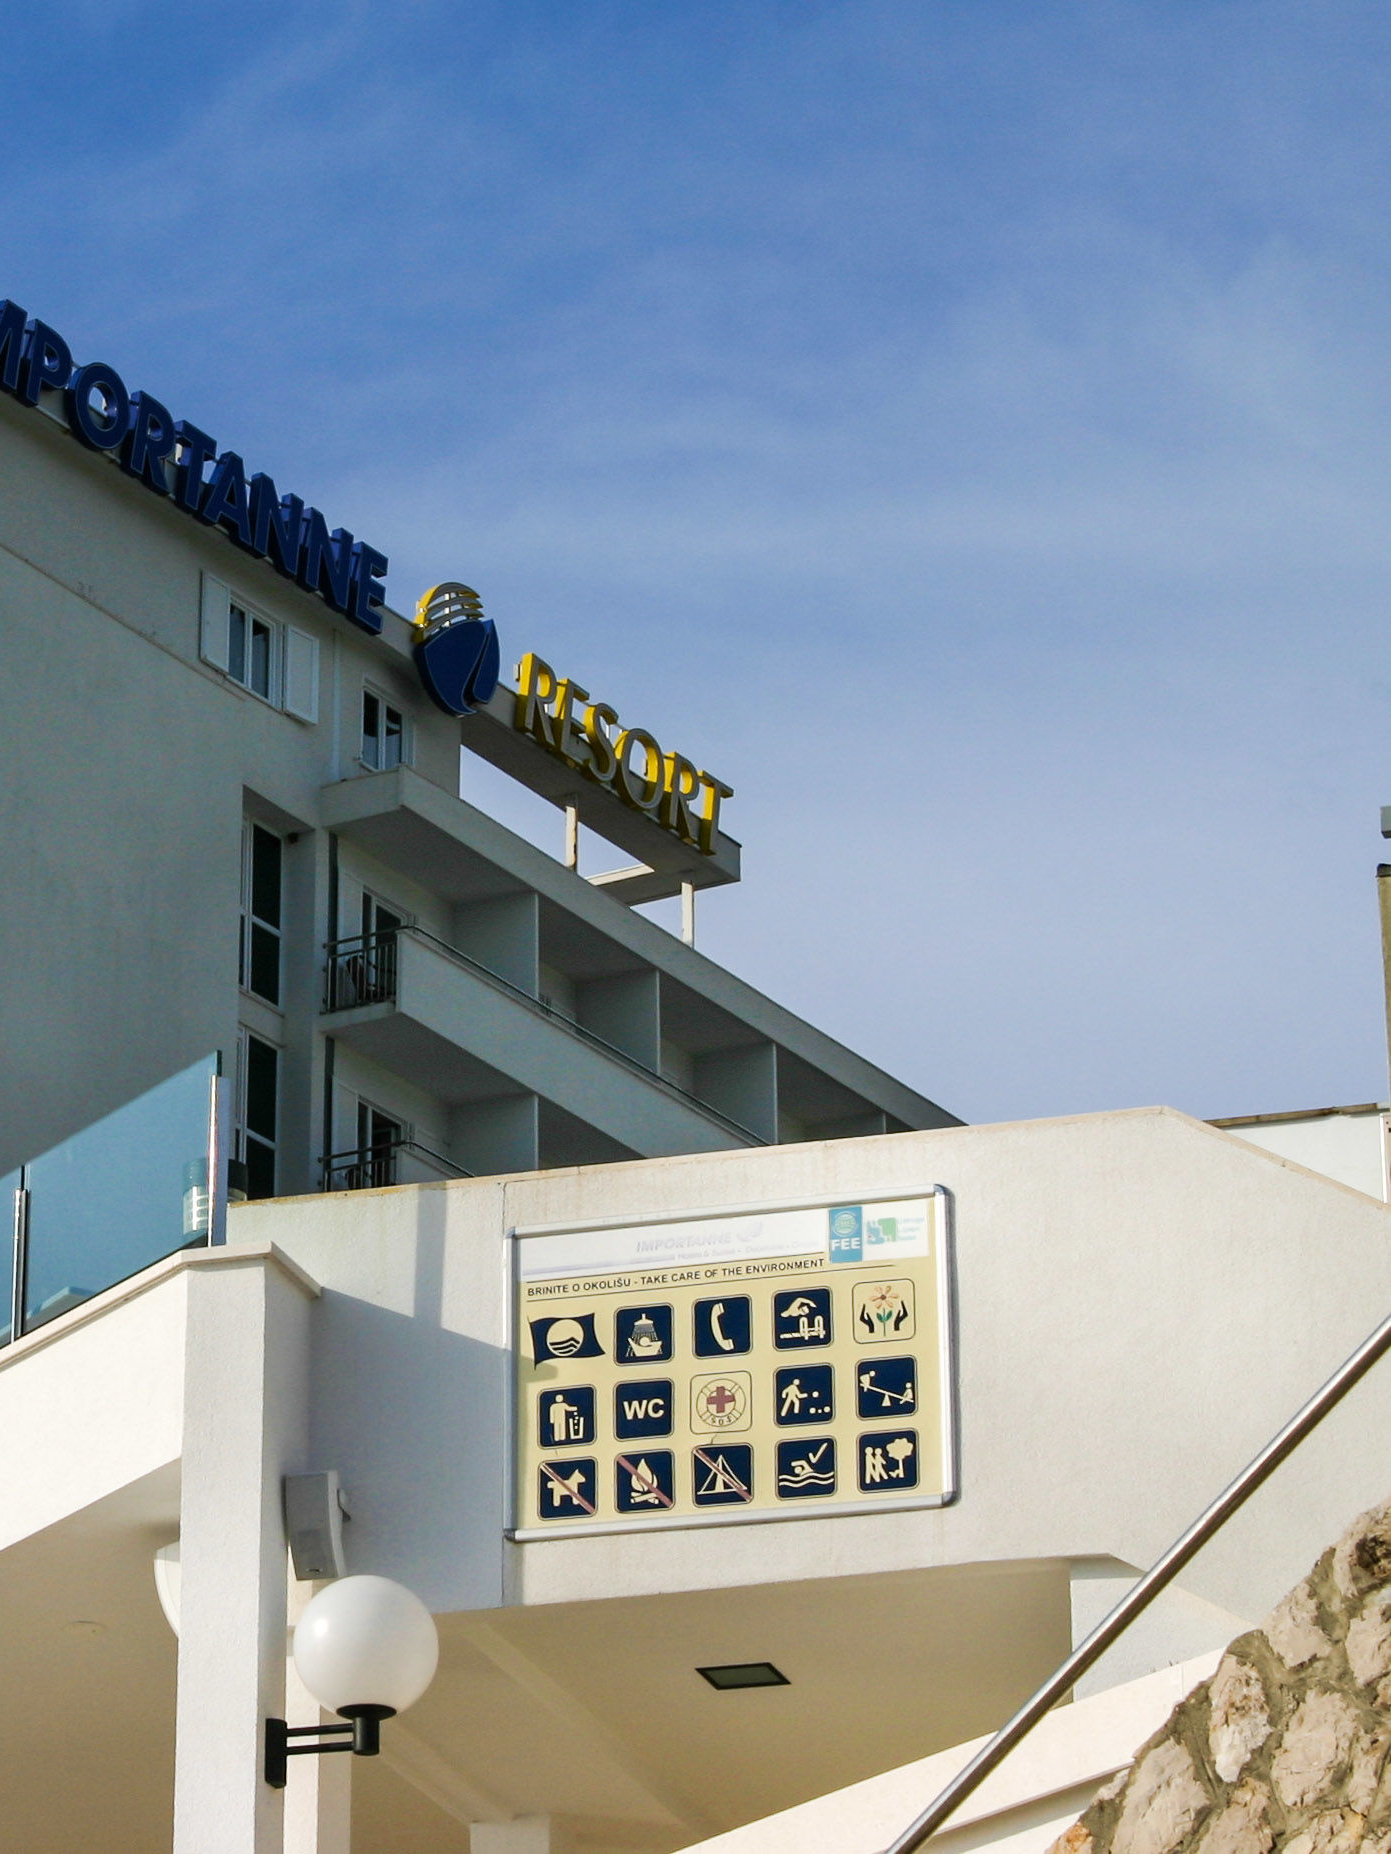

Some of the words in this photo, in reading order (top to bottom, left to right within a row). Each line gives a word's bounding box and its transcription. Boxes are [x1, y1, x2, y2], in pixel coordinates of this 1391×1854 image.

[515, 650, 733, 855] RESORT
[831, 1238, 860, 1251] FEE
[527, 1284, 569, 1296] BRINITE
[572, 1283, 580, 1292] O
[583, 1278, 631, 1291] OKOLIŠU
[640, 1274, 667, 1285] TAKE
[671, 1270, 701, 1282] CARE
[704, 1269, 718, 1278] OF
[722, 1266, 743, 1277] THE
[745, 1258, 825, 1274] ENVIRONMENT
[623, 1398, 665, 1420] WC
